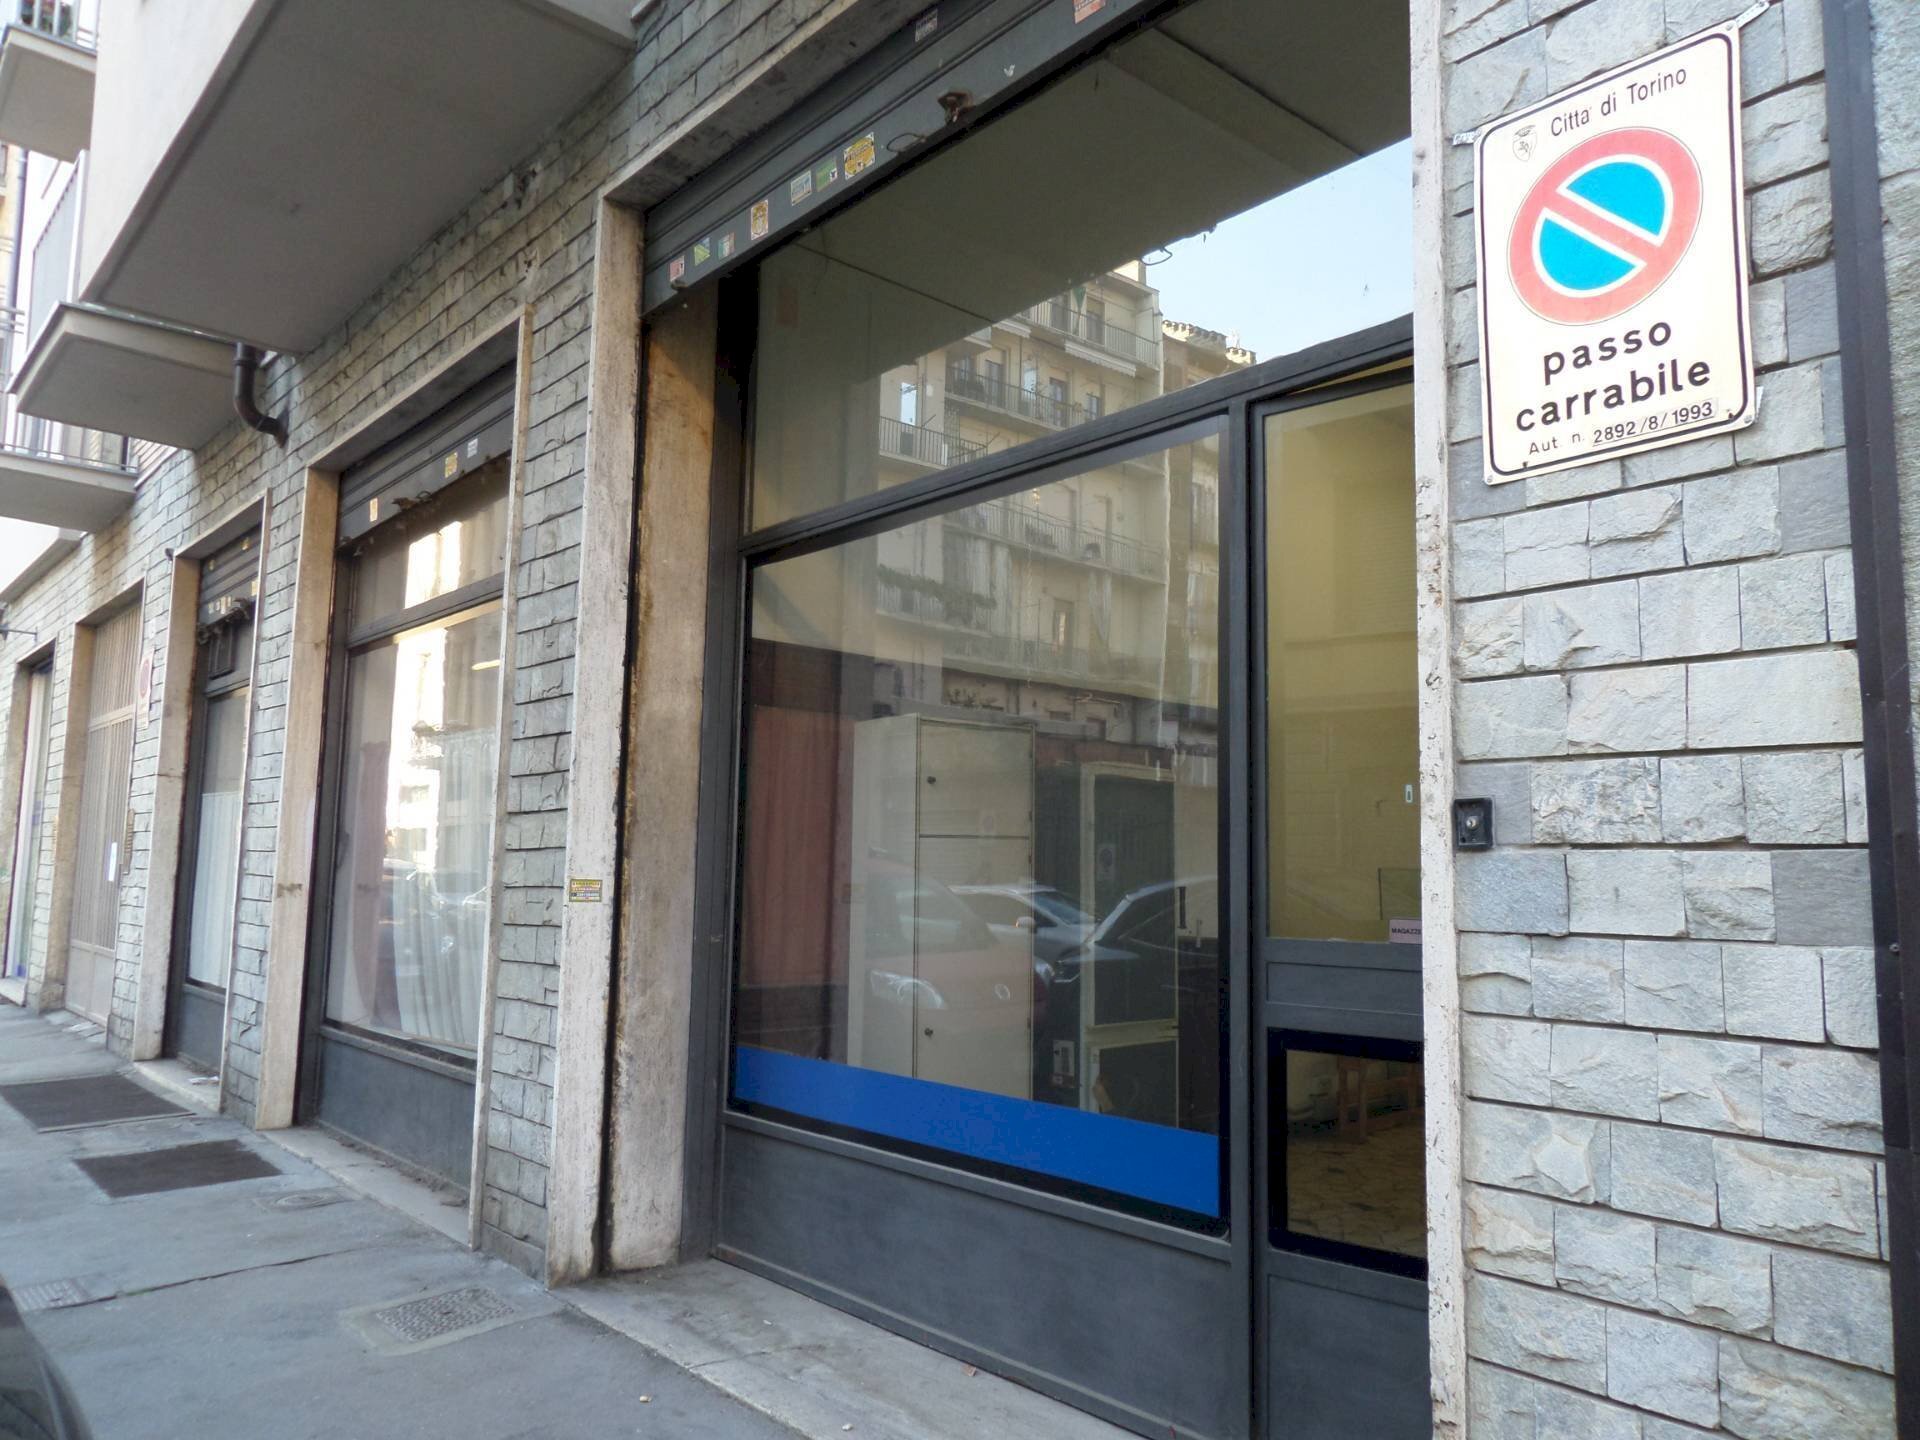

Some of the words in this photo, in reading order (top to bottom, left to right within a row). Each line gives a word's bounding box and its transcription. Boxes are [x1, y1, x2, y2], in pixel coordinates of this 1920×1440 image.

[1601, 92, 1616, 116] di
[1626, 69, 1687, 104] Torino
[1543, 322, 1672, 386] passo
[1516, 358, 1710, 431] carrabile
